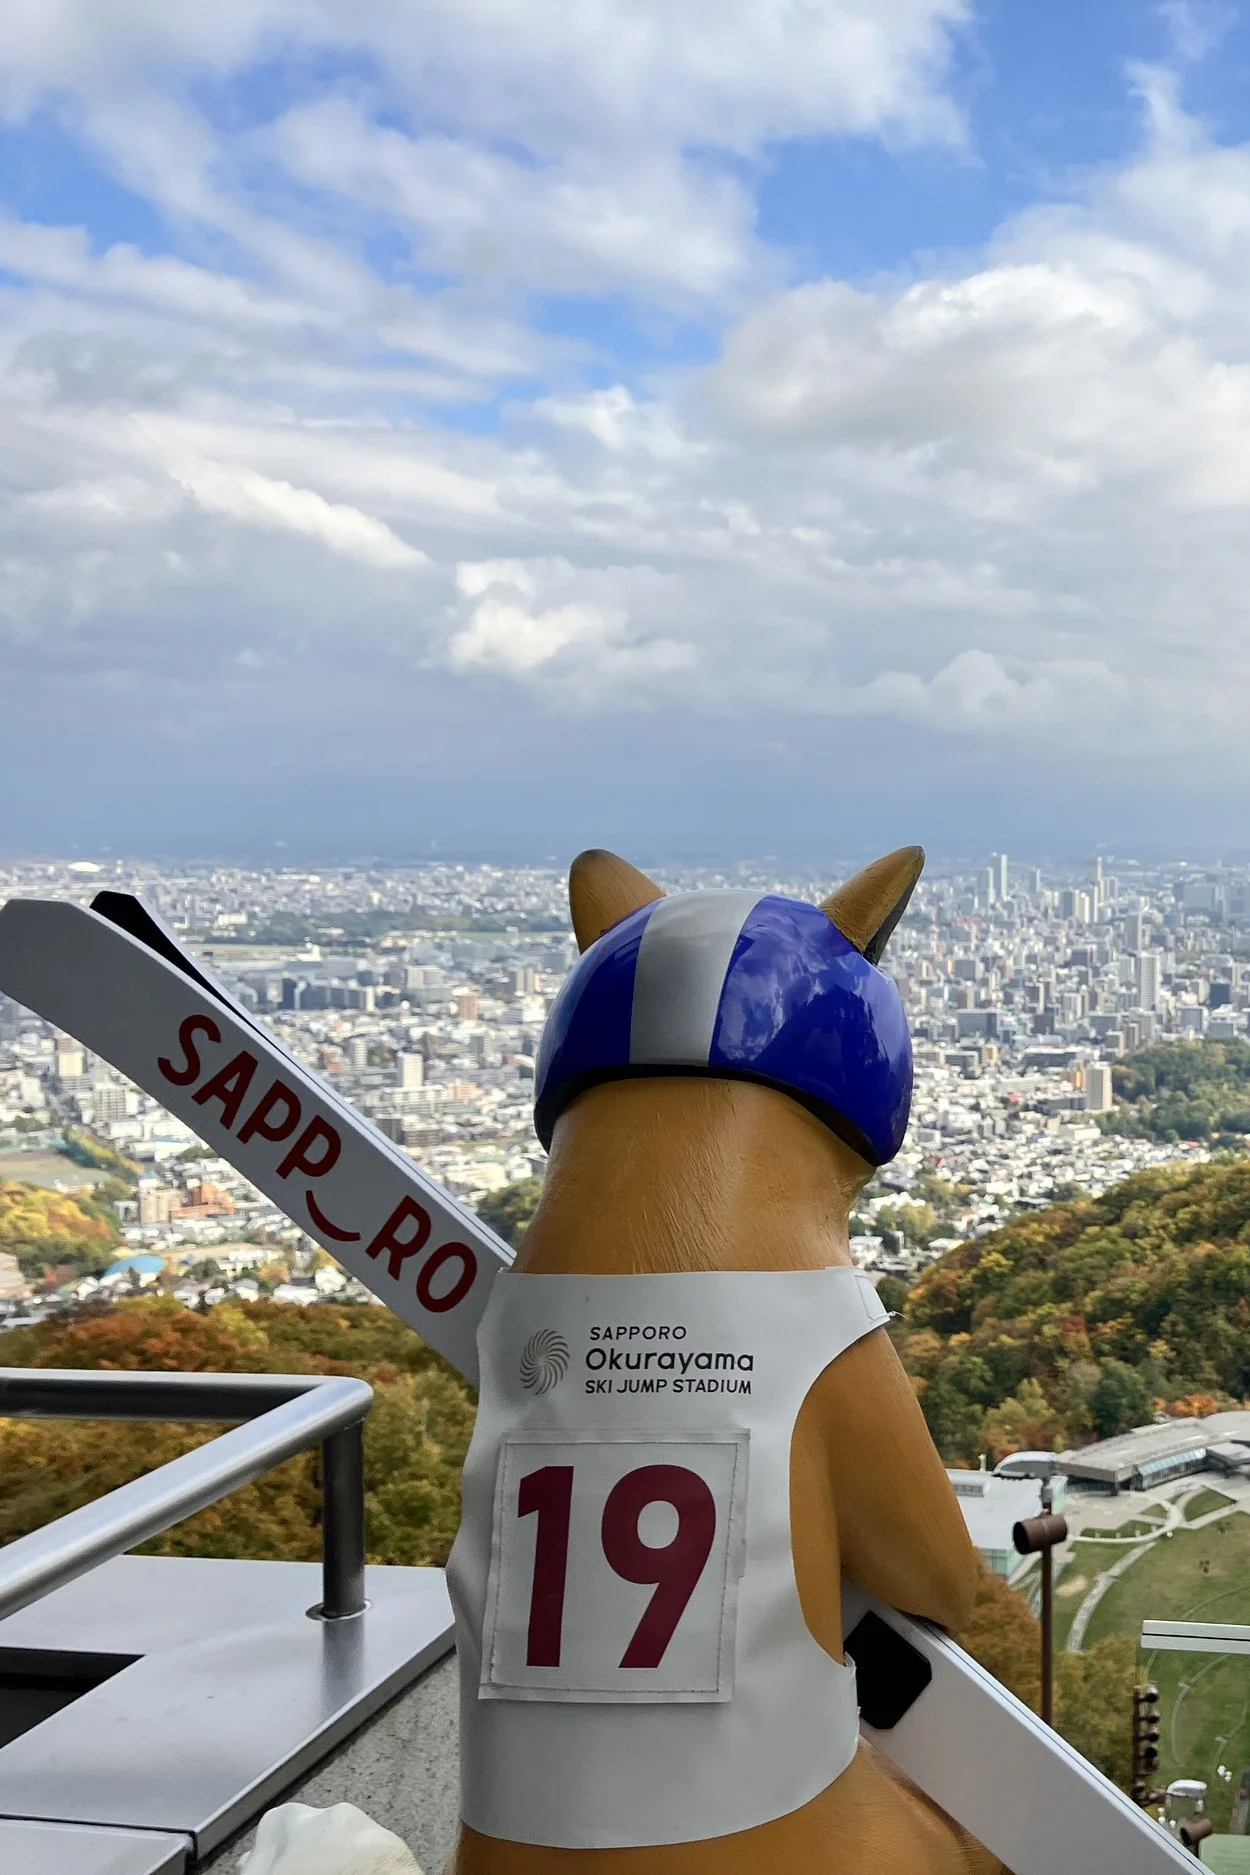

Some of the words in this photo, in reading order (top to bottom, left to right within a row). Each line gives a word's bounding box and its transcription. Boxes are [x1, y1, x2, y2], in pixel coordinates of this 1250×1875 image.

[589, 1325, 687, 1341] SAPPORO
[585, 1346, 755, 1375] Okurayama
[585, 1378, 613, 1395] SKI
[616, 1378, 668, 1394] JUMP
[672, 1378, 752, 1395] STADIUM
[518, 1464, 717, 1669] 19
